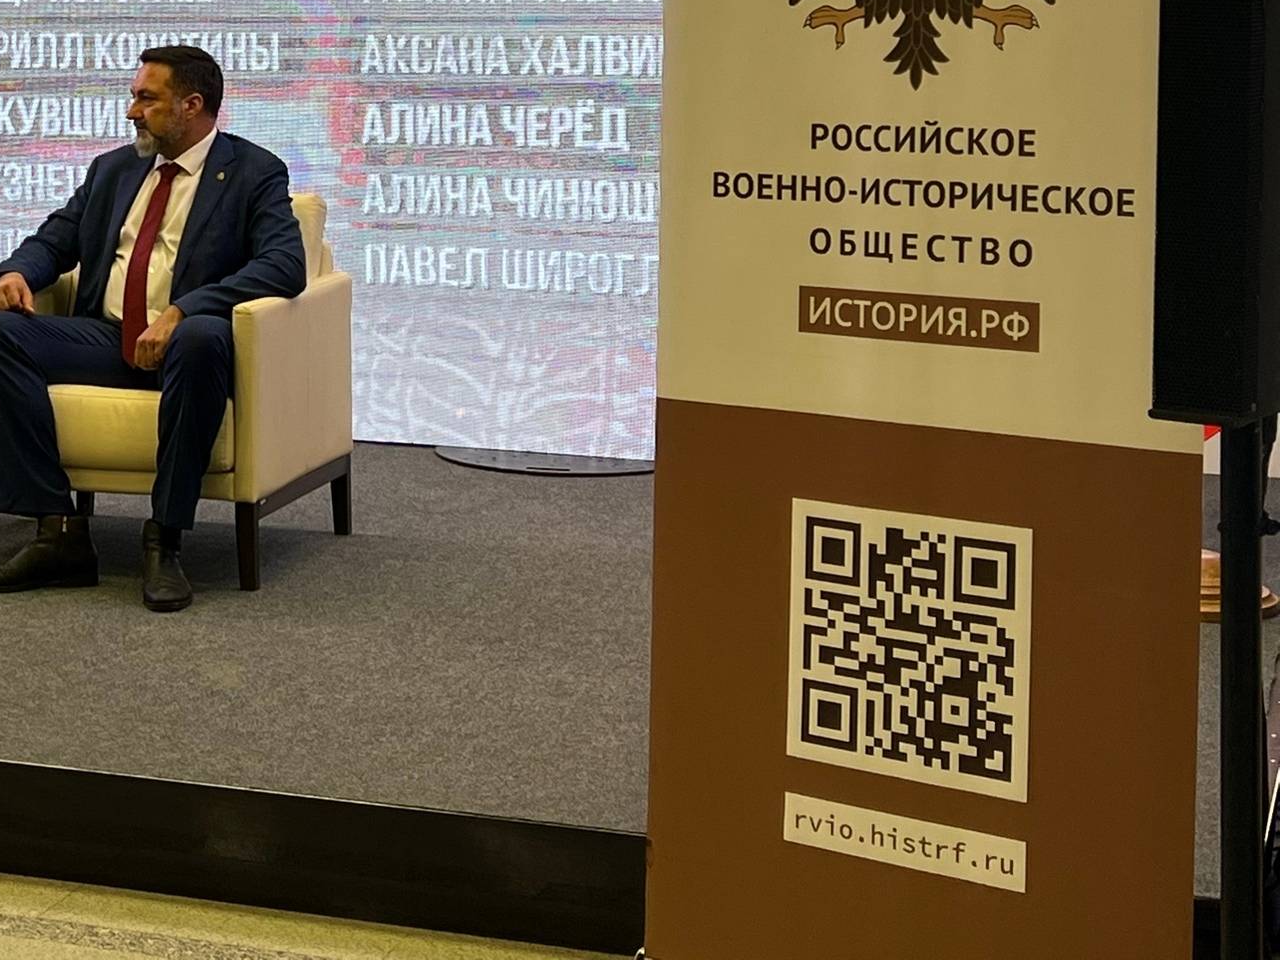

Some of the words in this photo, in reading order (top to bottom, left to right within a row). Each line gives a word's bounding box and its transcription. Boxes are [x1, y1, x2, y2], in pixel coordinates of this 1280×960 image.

[361, 34, 509, 75] АКСАНА
[362, 103, 493, 146] АЛИНА
[503, 99, 630, 151] ЧЕРЁД
[810, 121, 1036, 157] РОССИЙСКОЕ
[363, 173, 494, 217] АЛИНА
[712, 172, 1135, 217] ВОЕННО-ИСТОРИЧЕСКОЕ
[364, 244, 489, 289] ПАВЕЛ
[809, 227, 1033, 268] ОБЩЕСТВО
[808, 296, 1030, 341] ИСТОРИЯ.РФ
[795, 812, 1014, 875] rvio.histrf.ru
